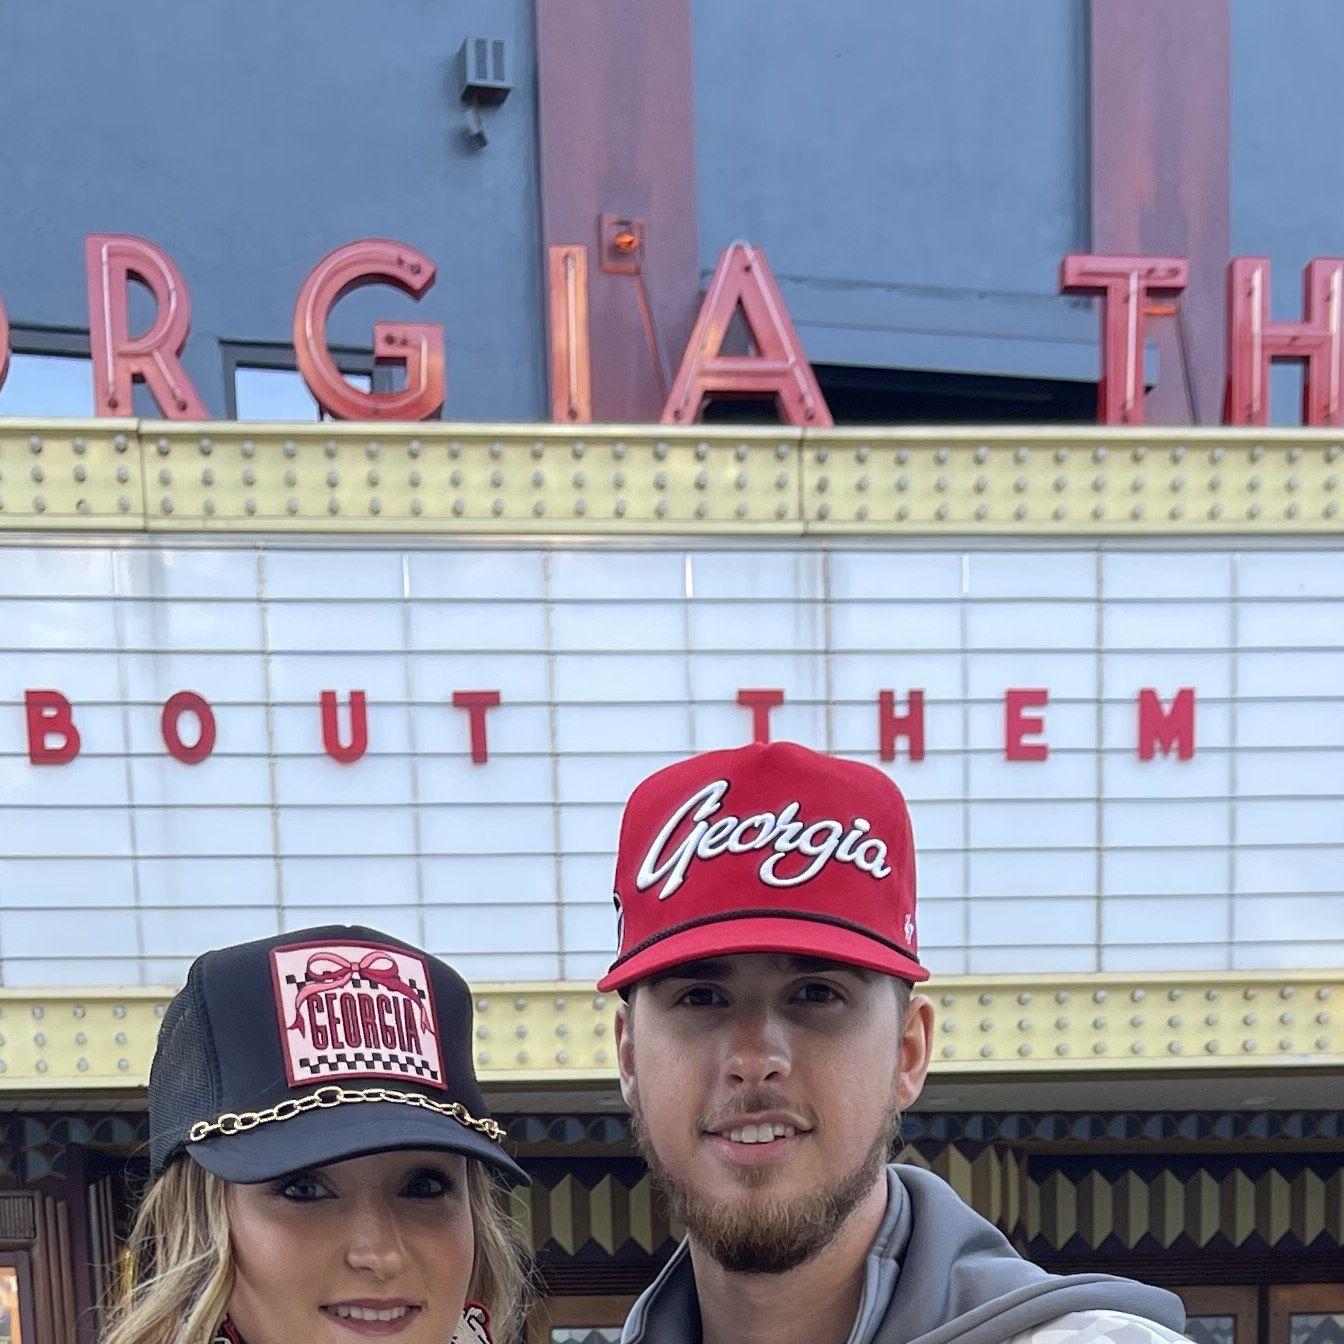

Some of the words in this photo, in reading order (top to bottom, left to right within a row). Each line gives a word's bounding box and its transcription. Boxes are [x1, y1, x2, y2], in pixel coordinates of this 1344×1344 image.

[25, 688, 501, 766] BOUT
[736, 686, 1196, 764] THEM
[636, 779, 892, 900] Georgia
[307, 991, 424, 1056] GEORGIA
